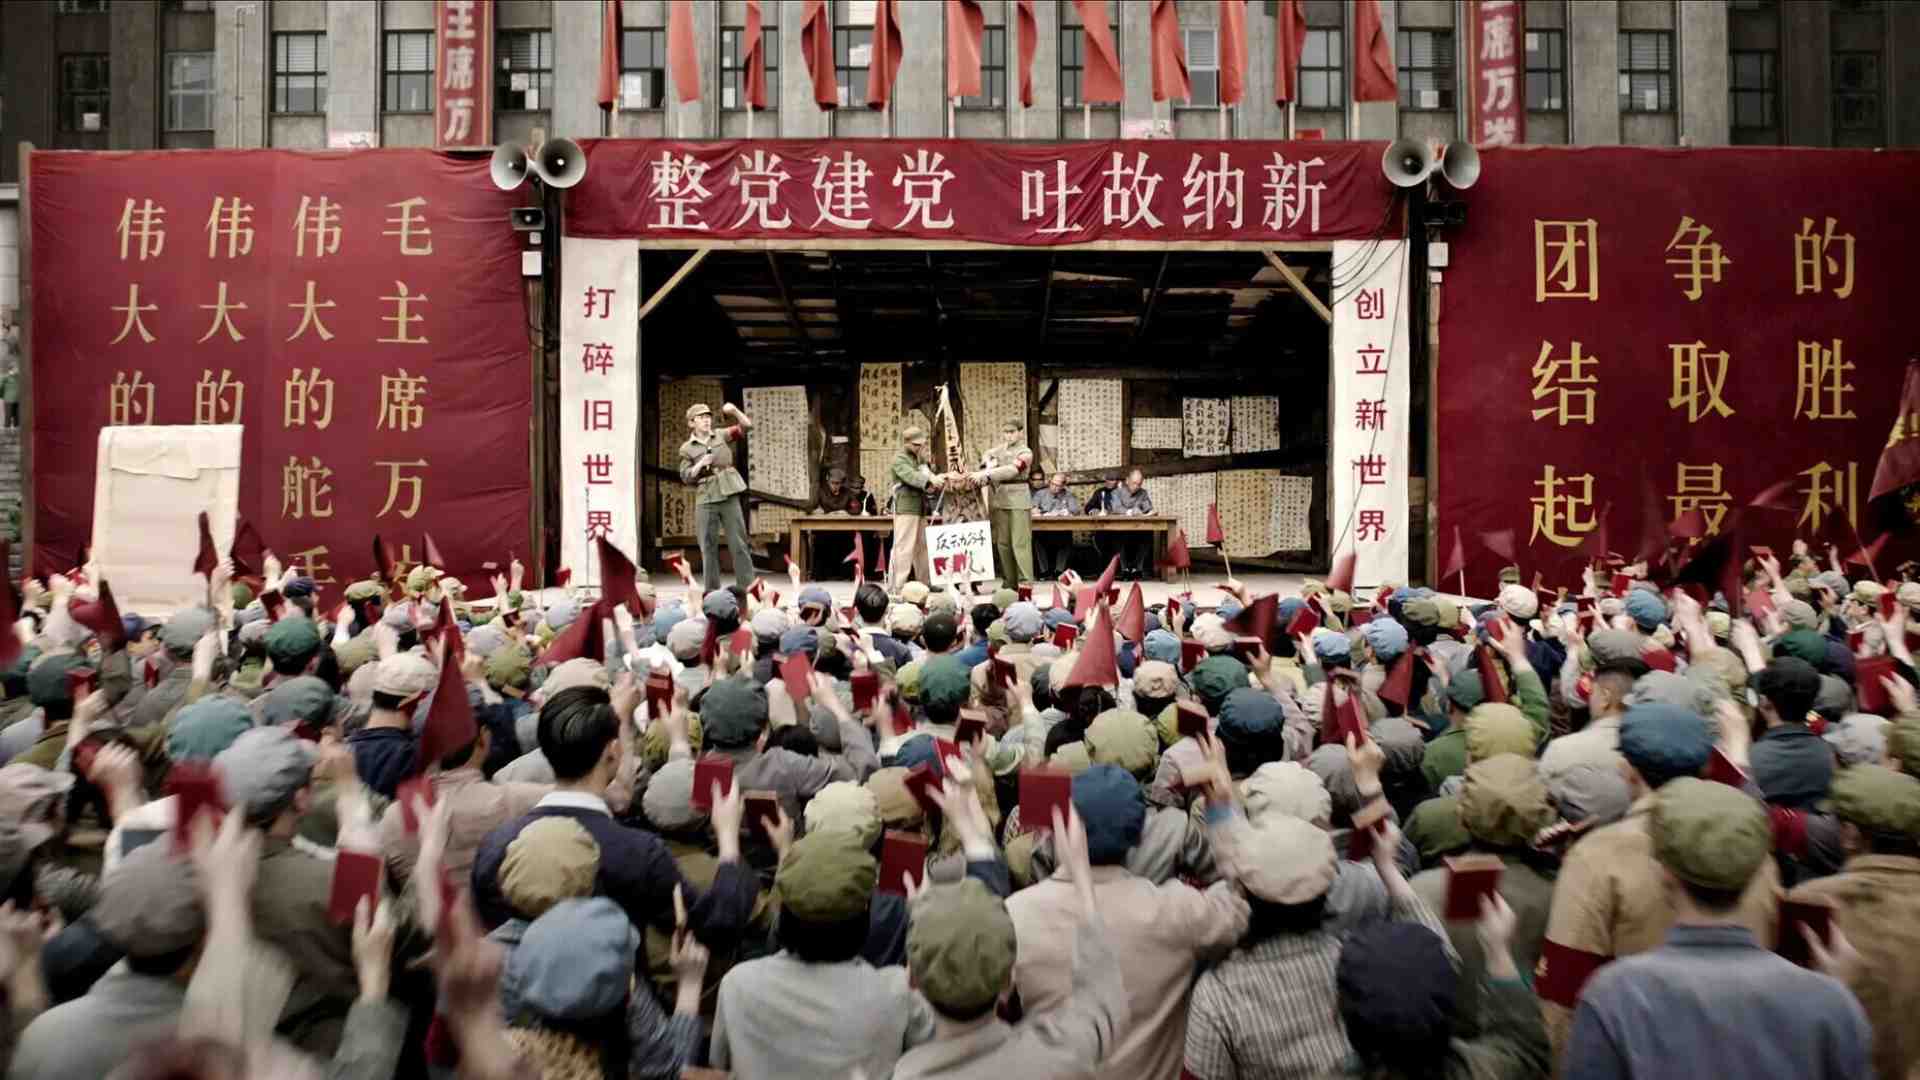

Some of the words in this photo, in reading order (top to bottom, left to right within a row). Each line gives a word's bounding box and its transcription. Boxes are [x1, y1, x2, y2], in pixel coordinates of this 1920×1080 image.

[648, 150, 955, 230] 整党建党
[1021, 150, 1327, 233] 吐故纳新
[582, 285, 616, 541] 打碎旧世界
[1355, 288, 1388, 541] 创立新世界
[1528, 217, 1599, 547] 团结起
[1793, 216, 1857, 530] 的胜利
